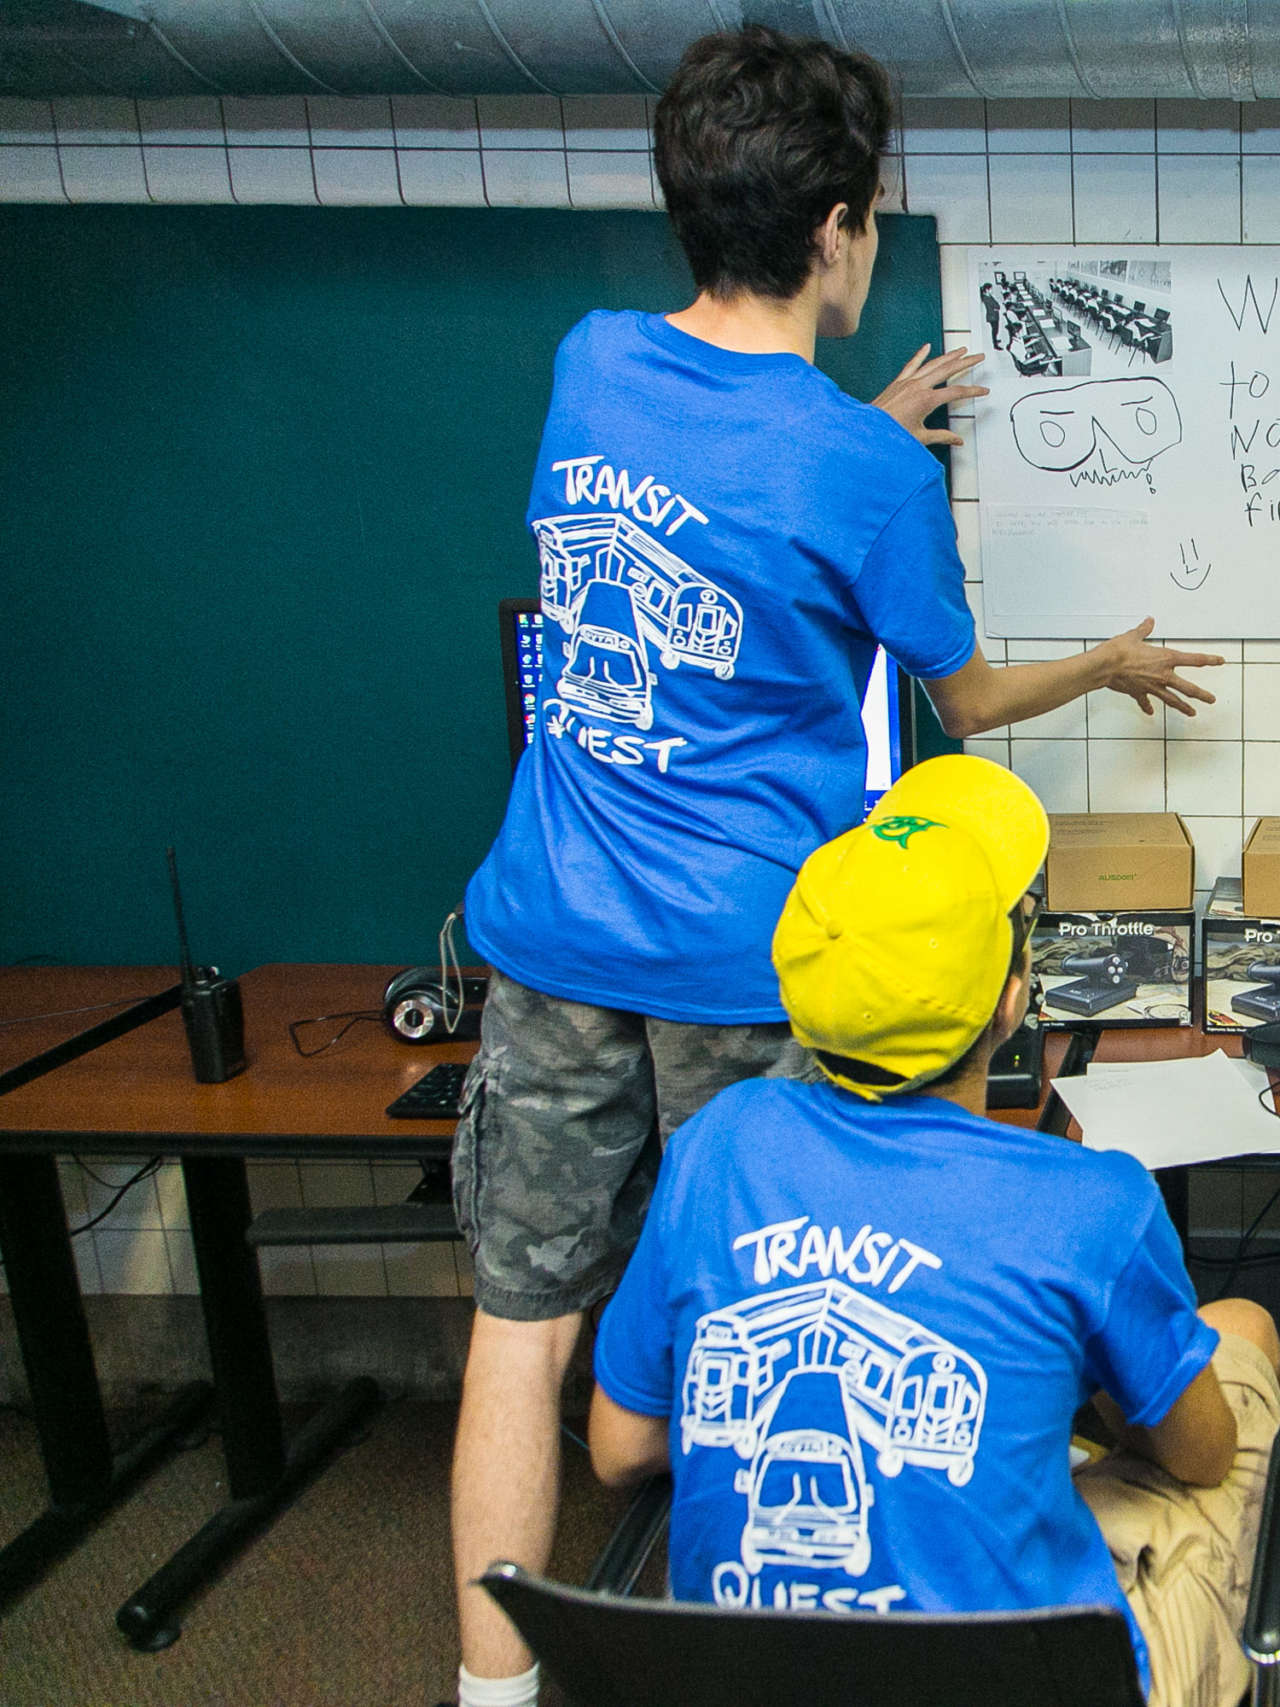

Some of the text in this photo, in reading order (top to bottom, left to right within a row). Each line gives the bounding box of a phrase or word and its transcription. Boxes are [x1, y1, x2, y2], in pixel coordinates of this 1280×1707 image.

[1219, 361, 1270, 420] to
[552, 455, 710, 536] TRANSIT
[1058, 921, 1155, 936] Pro Throttle
[1244, 928, 1273, 943] Pro
[733, 1216, 942, 1293] TRANSIT
